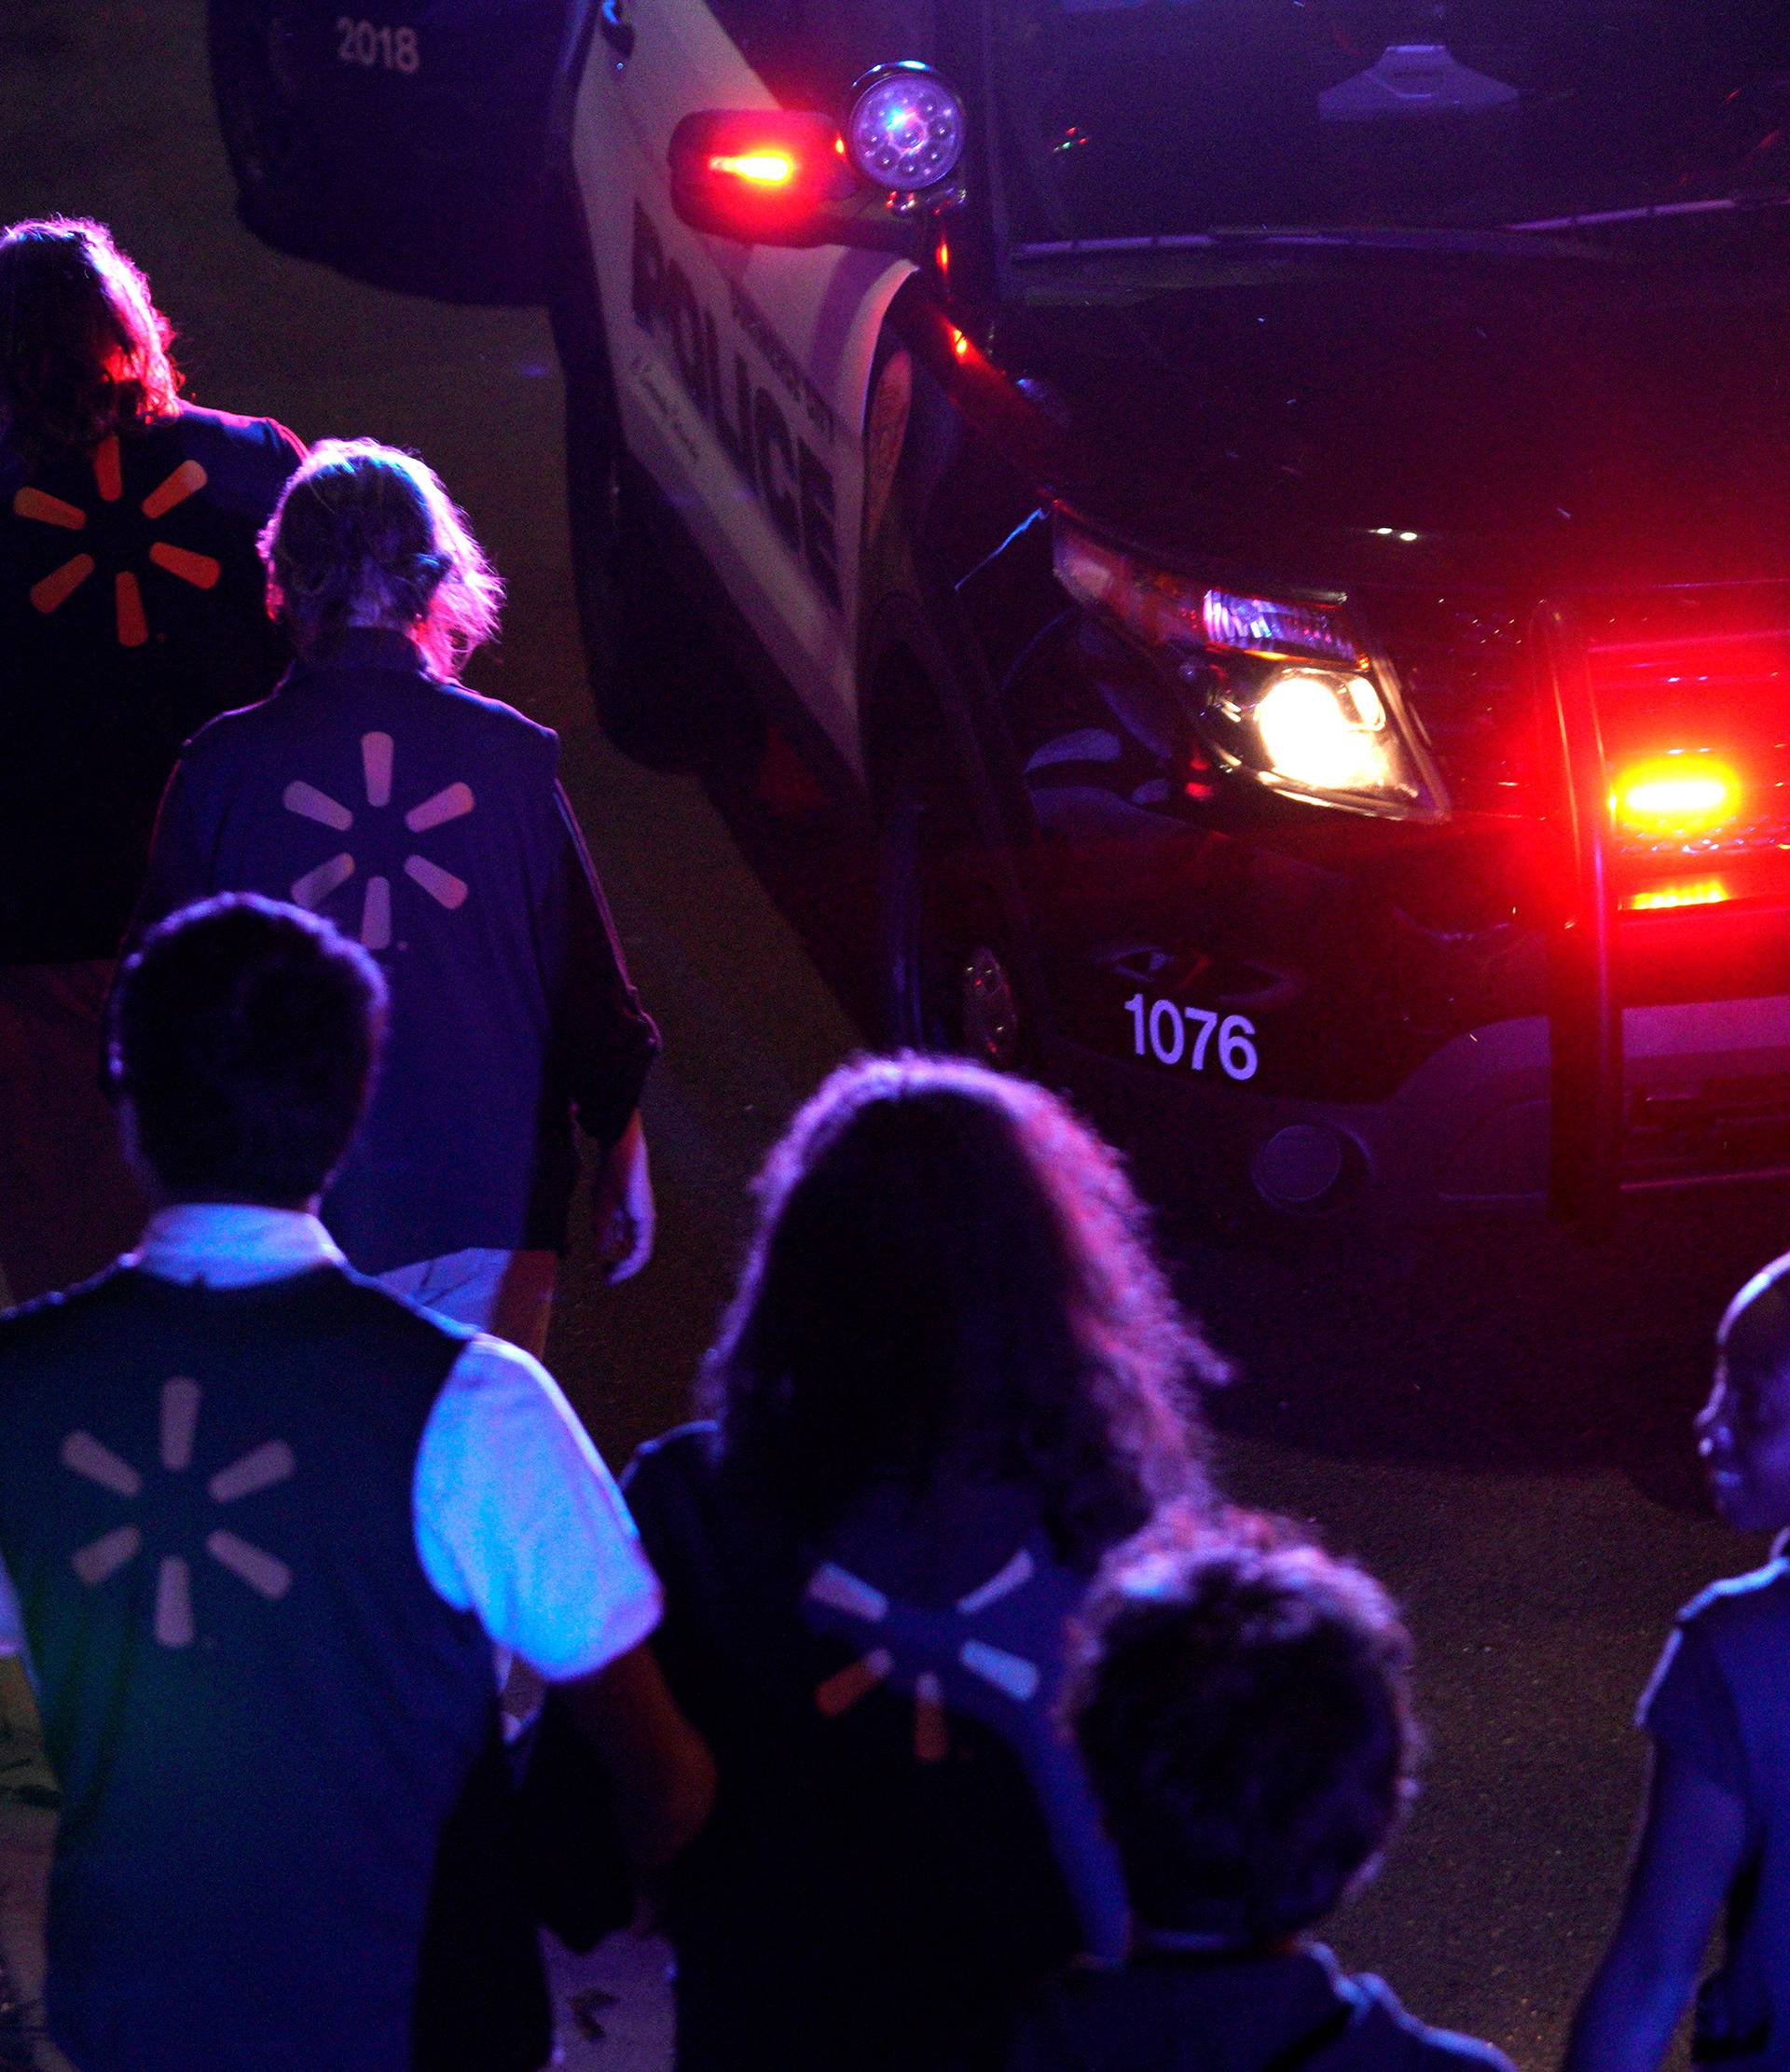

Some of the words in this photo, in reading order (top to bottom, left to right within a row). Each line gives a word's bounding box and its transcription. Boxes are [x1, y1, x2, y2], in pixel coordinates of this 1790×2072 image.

[337, 17, 419, 74] 2018
[633, 197, 842, 611] POLICE
[1123, 992, 1259, 1082] 1076
